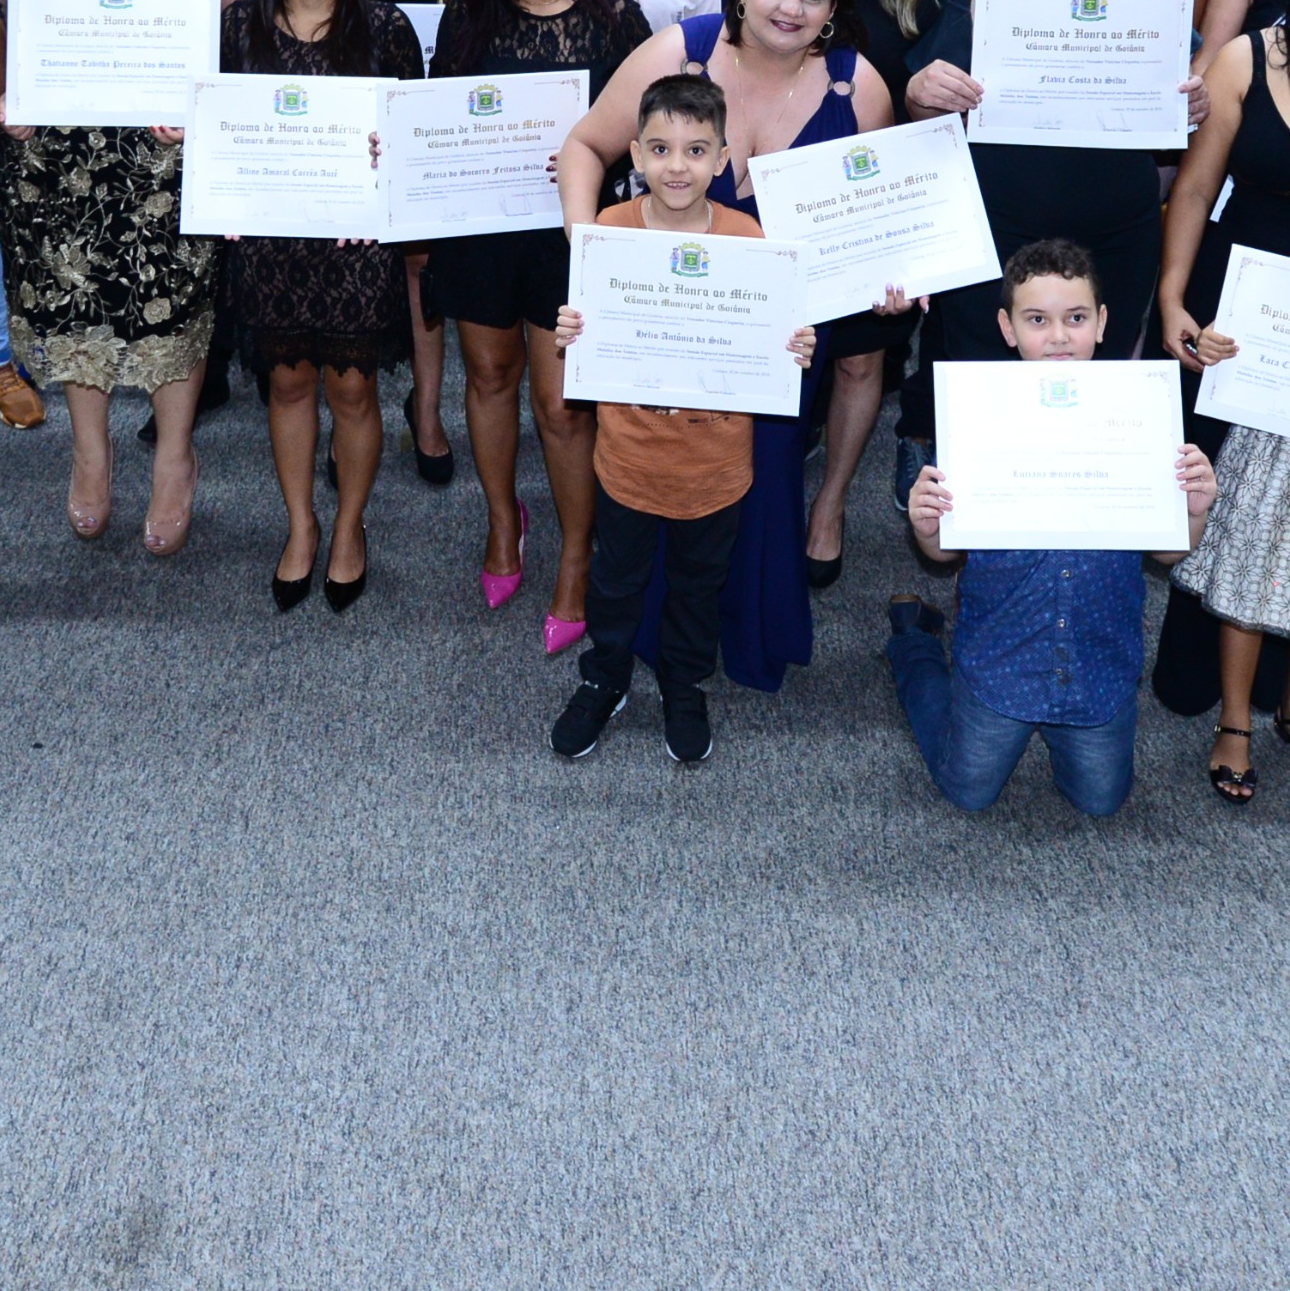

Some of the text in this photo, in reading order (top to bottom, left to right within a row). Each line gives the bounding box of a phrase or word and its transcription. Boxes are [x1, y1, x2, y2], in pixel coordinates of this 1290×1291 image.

[44, 14, 85, 26] Diploma
[88, 15, 99, 25] de
[102, 14, 134, 25] Honra
[152, 16, 186, 26] Mérito
[1011, 26, 1159, 39] Diploma de Honra ao Mérito
[1025, 41, 1145, 53] Câmara Municipal de Goiânia
[1067, 75, 1091, 84] Costa
[1093, 76, 1102, 84] da
[1104, 76, 1127, 84] Silva
[219, 120, 260, 132] Diploma
[263, 122, 274, 132] de
[277, 121, 309, 133] Honra
[327, 124, 361, 134] Mérito
[412, 127, 455, 138] Diploma
[458, 124, 469, 134] de
[472, 122, 504, 133] Honra
[522, 118, 555, 129] Mérito
[232, 135, 346, 147] Câmara Municipal de Goiânia
[427, 133, 541, 149] Câmara Municipal de Goiânia
[422, 163, 544, 180] Maria do Socorro Feitosa Silva
[794, 172, 938, 214] Diploma de Honra ao Mérito
[812, 189, 927, 223] Câmara Municipal de Goiânia
[818, 244, 840, 256] Kelly
[841, 236, 873, 250] Cristina
[884, 226, 911, 238] Sousa
[911, 221, 934, 232] Silva
[609, 277, 767, 301] Diploma de Honra ao Mérito
[623, 294, 750, 314] Câmara Municipal de Goiânia
[635, 329, 731, 346] Hélio Antônio da Silva
[1259, 353, 1279, 366] Lara
